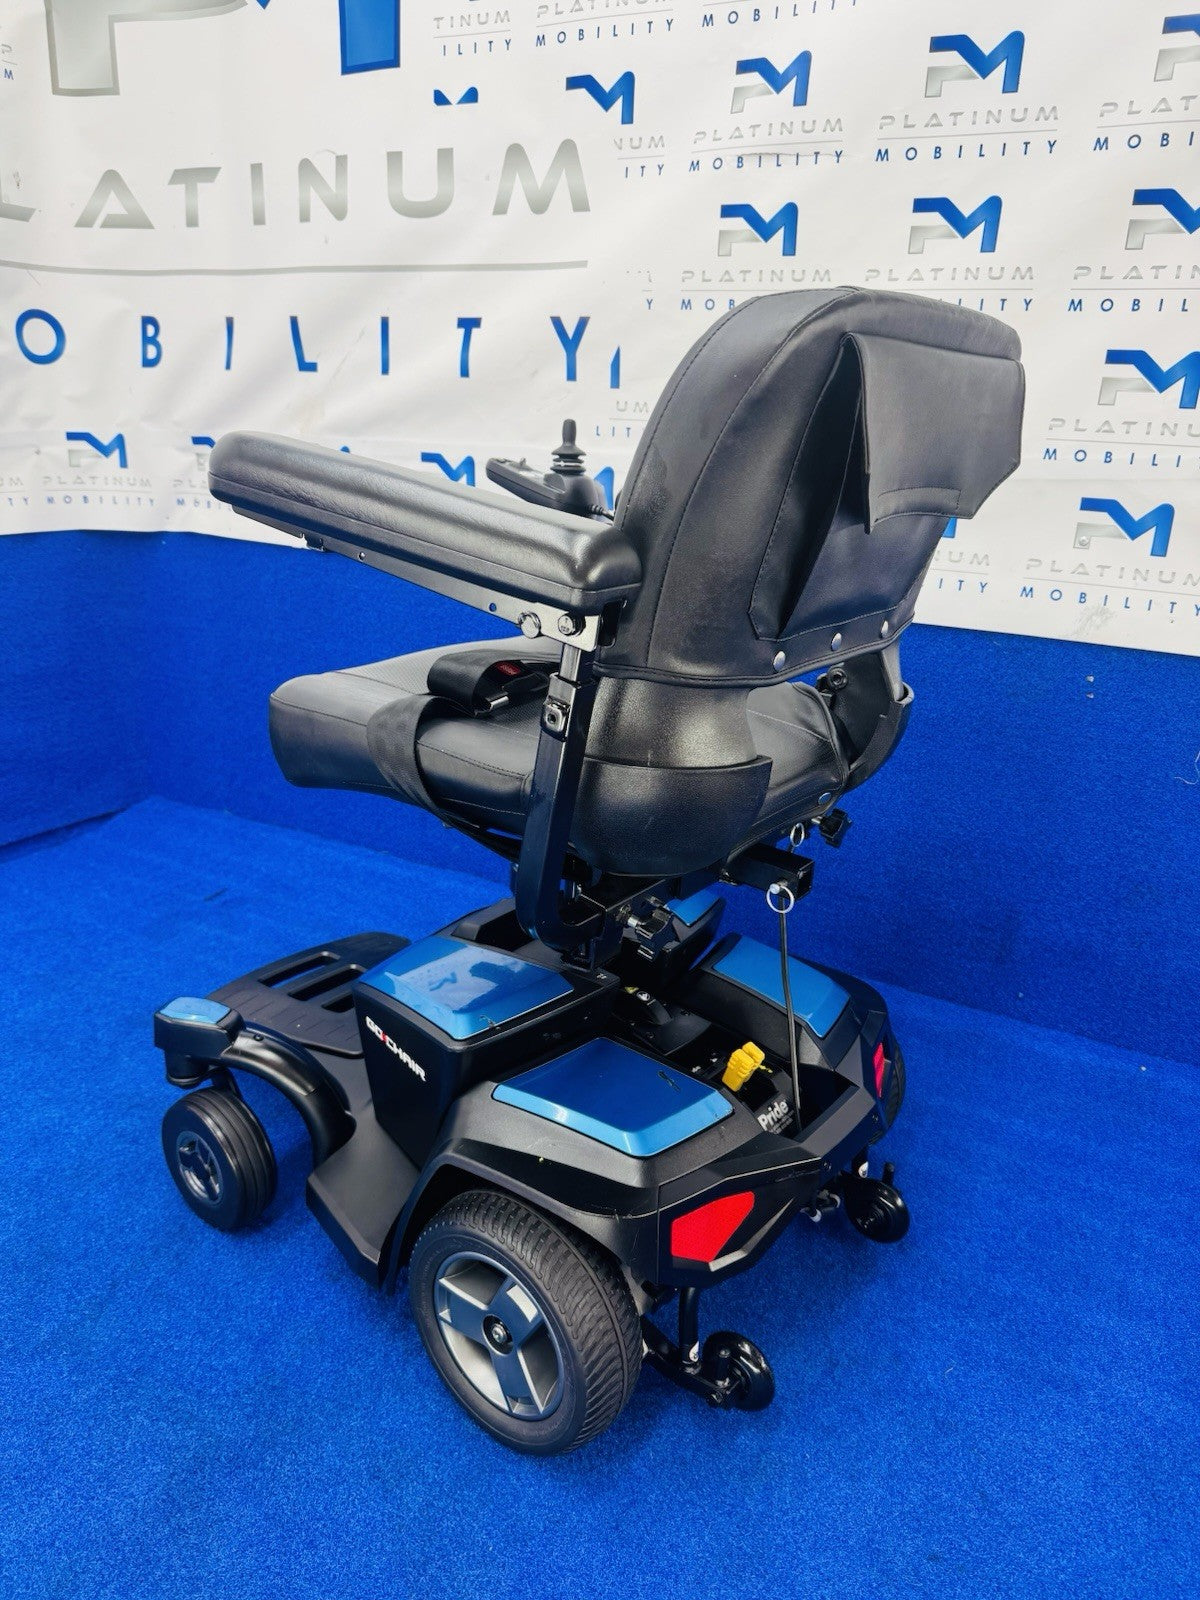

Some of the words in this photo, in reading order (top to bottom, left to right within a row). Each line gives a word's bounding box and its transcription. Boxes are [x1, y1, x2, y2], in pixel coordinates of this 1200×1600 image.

[536, 19, 674, 47] MOBILITY
[878, 105, 1060, 130] PLATINUM
[693, 118, 843, 144] PLATINUM
[689, 150, 843, 173] MOBILITY
[876, 140, 1058, 162] MOBILITY
[681, 269, 832, 283] PLATINUM
[865, 266, 1034, 281] PLATINUM
[1042, 447, 1200, 468] MOBILI
[42, 475, 152, 488] PLATINUM
[47, 494, 155, 506] MOBILITY
[1026, 558, 1200, 586] PLATINUM
[1020, 586, 1200, 616] MOBILITY
[757, 1099, 789, 1131] Pride
